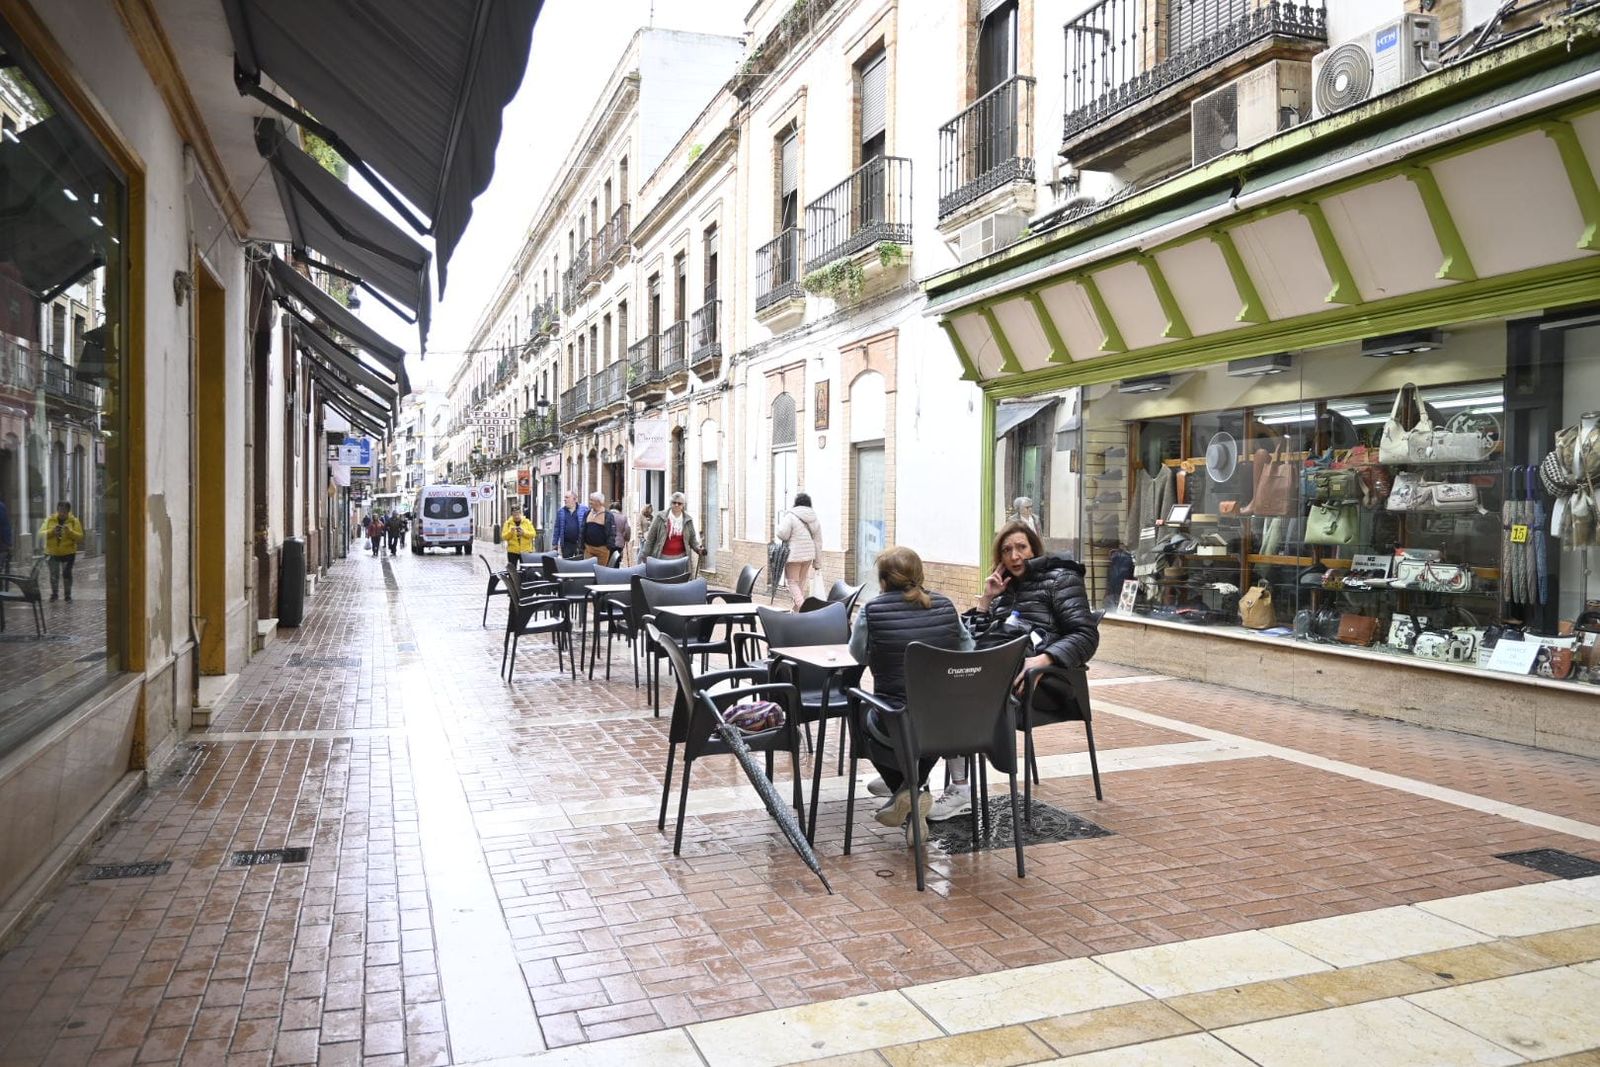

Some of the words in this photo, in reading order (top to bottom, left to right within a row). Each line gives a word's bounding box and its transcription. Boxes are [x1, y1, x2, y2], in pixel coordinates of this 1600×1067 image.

[474, 411, 509, 419] FOTO
[1512, 527, 1525, 540] 15
[947, 666, 982, 675] Cruzcampo
